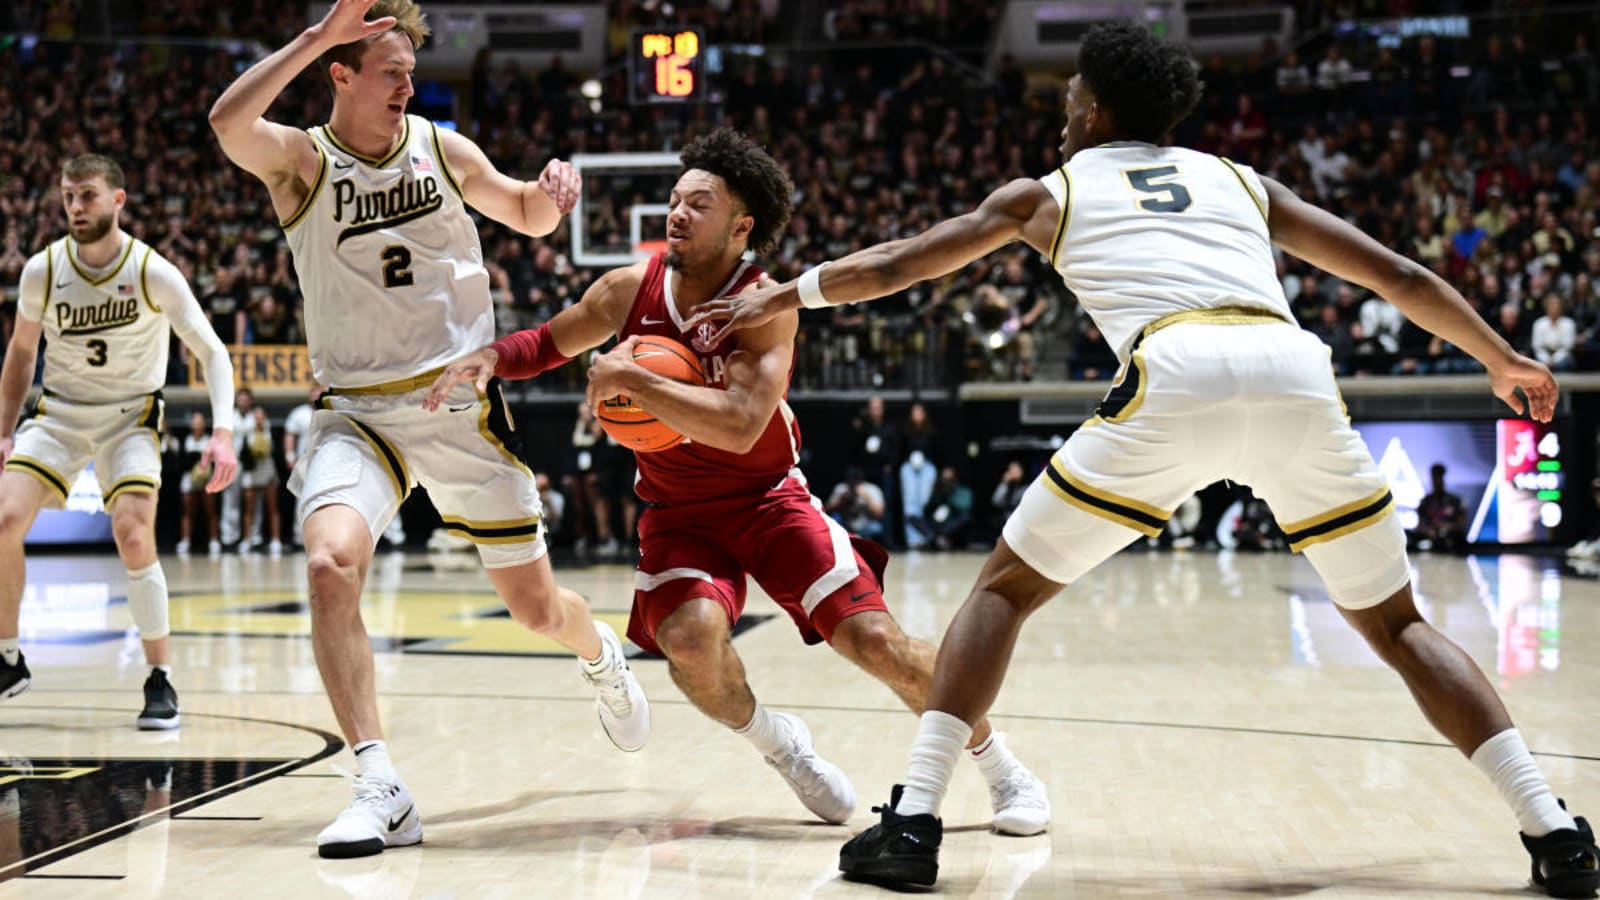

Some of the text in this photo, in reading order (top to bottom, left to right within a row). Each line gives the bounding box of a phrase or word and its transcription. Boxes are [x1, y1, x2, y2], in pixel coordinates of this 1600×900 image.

[656, 53, 693, 96] 16
[332, 174, 443, 236] Purdue
[1120, 164, 1193, 214] 5
[381, 244, 414, 289] 2
[55, 295, 139, 333] Purdue
[86, 339, 108, 368] 3
